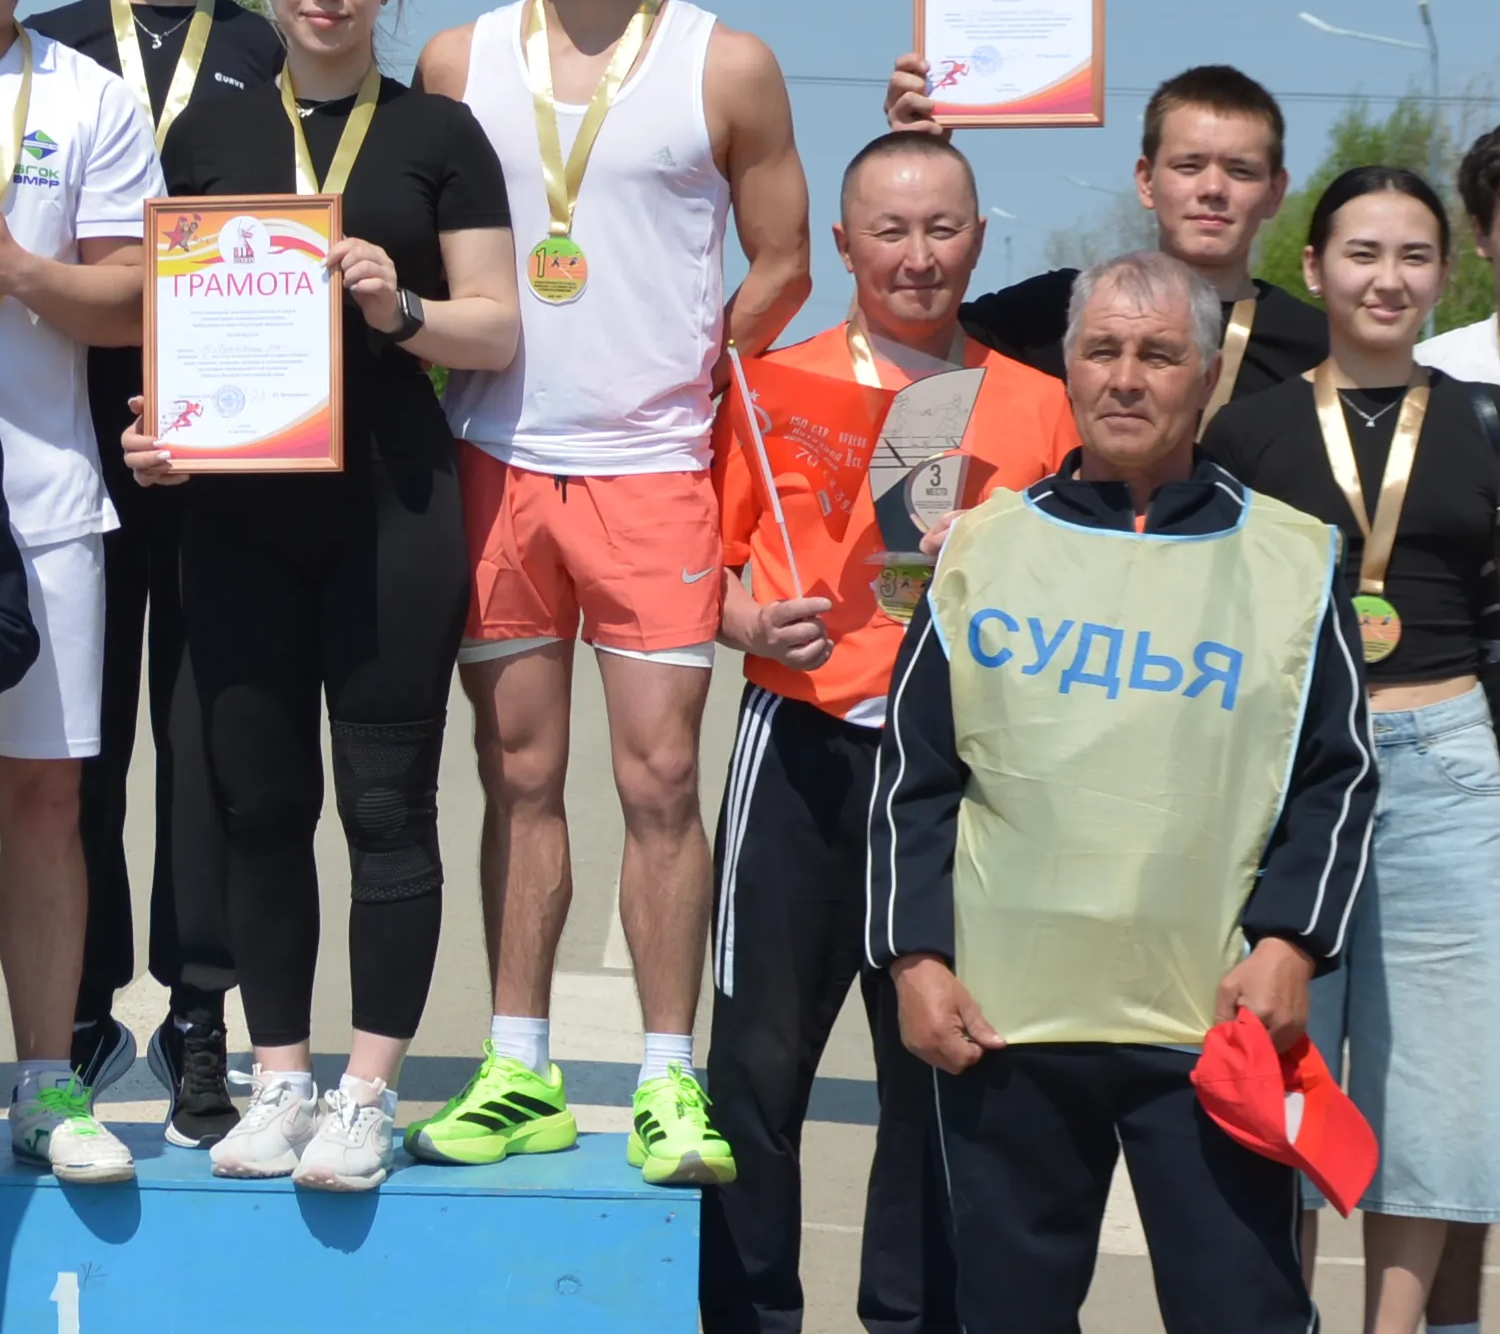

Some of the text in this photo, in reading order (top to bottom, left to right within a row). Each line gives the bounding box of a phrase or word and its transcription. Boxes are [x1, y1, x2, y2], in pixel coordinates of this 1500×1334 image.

[536, 247, 546, 278] 1
[173, 271, 315, 297] ГРАМОТА
[929, 463, 942, 487] 3
[879, 567, 897, 598] 3
[967, 608, 1244, 712] СУДЬЯ
